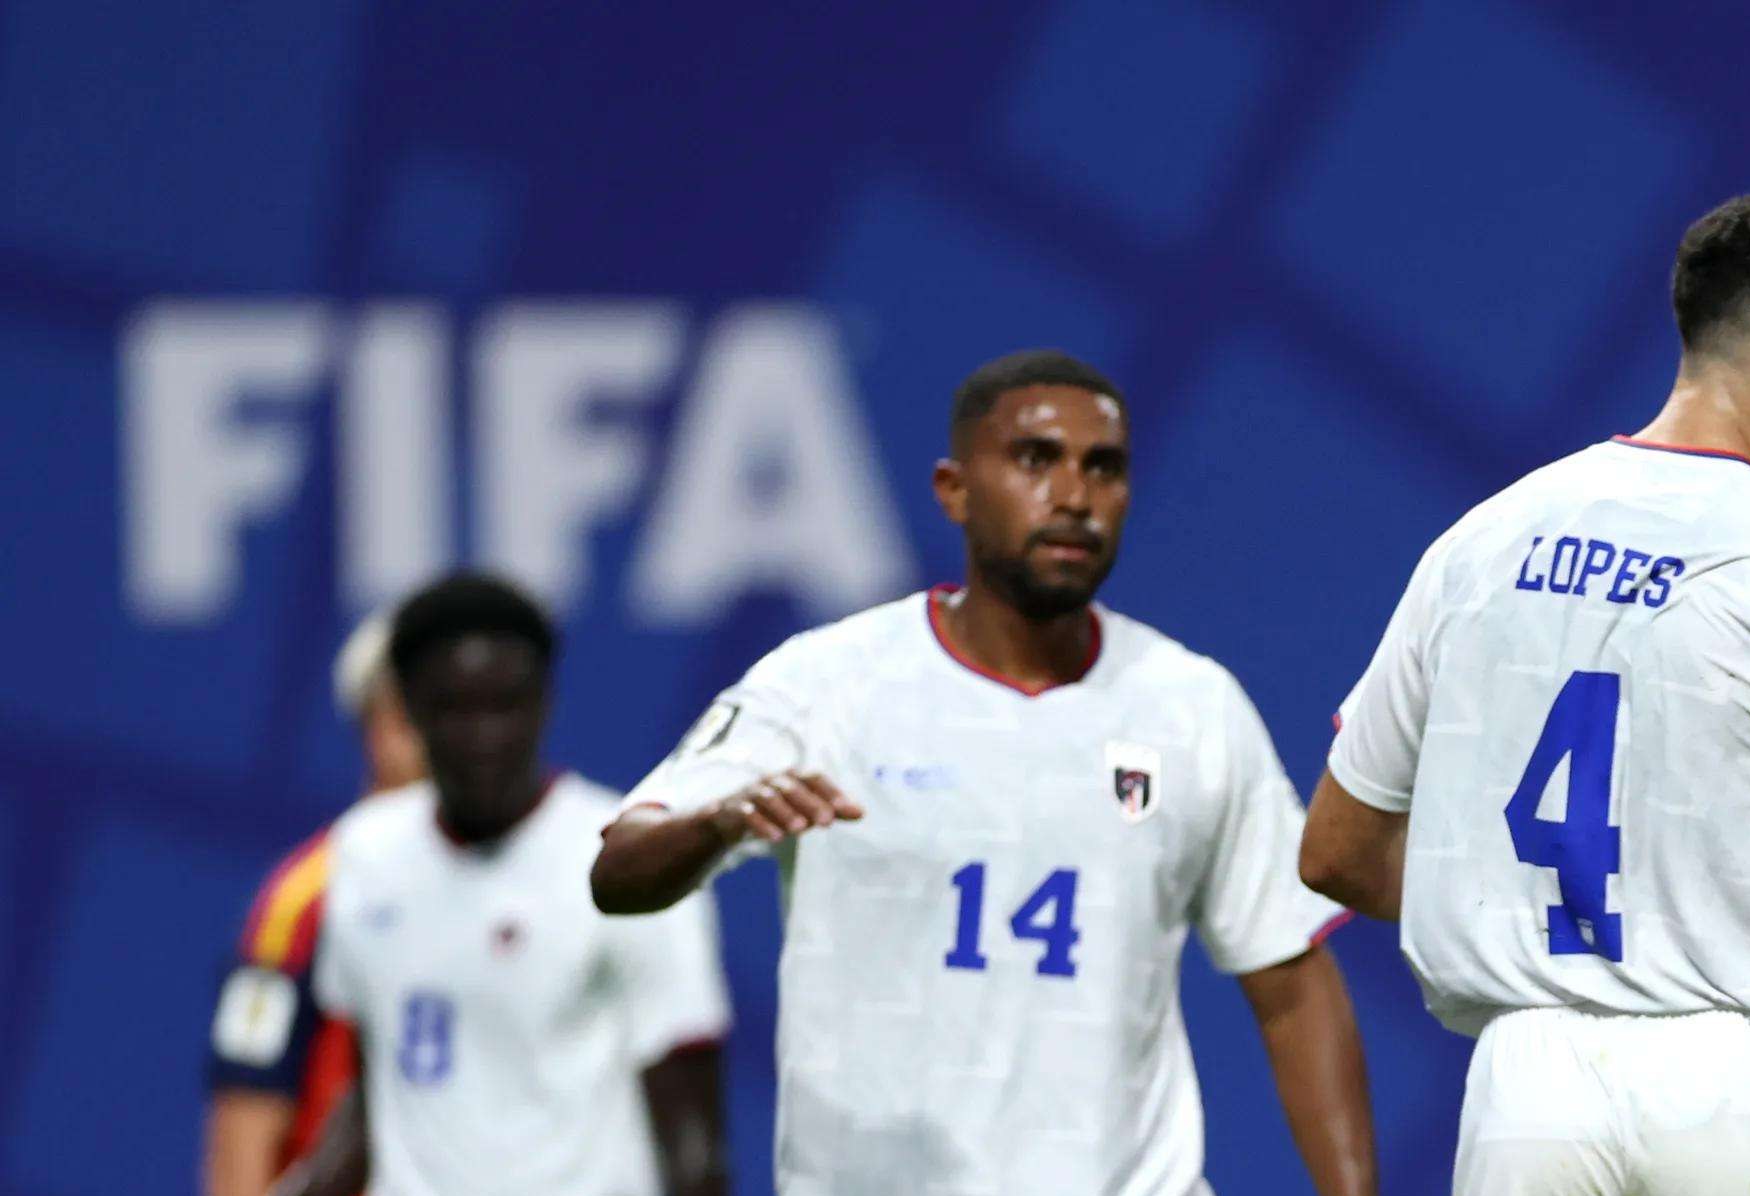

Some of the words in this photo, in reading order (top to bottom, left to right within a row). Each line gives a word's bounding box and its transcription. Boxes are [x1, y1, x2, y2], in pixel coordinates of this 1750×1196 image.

[118, 300, 918, 630] FIFA
[1515, 536, 1686, 609] LOPES
[1504, 670, 1624, 963] 4
[945, 863, 1081, 978] 14
[398, 993, 455, 1087] 8
